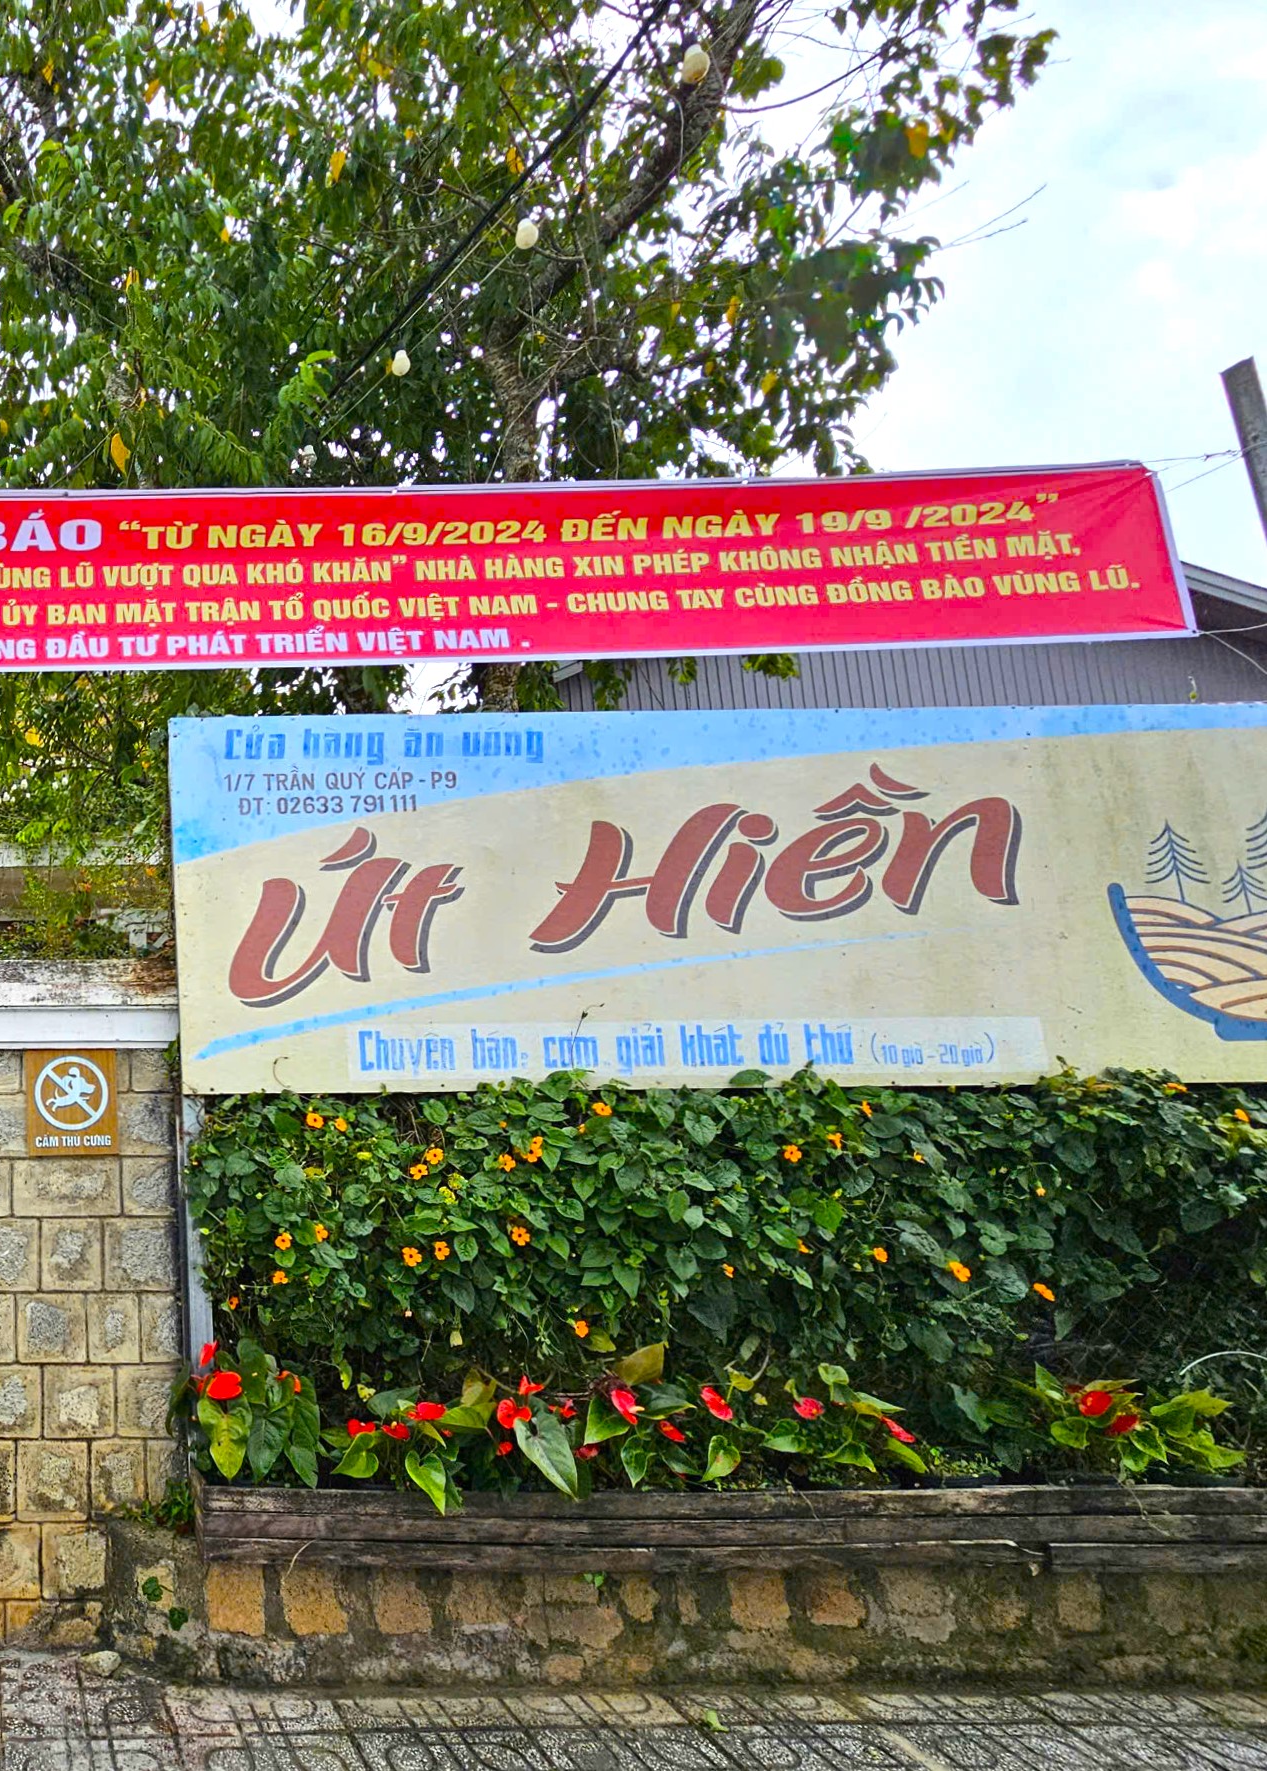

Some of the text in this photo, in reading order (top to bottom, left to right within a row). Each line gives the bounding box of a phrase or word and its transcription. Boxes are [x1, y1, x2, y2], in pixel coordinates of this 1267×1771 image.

[208, 519, 323, 549] NGÀY
[338, 520, 547, 546] 16/9/2024
[560, 510, 648, 542] ĐẾN
[662, 509, 780, 539] NGÀY
[60, 561, 94, 588] LŨ
[102, 562, 174, 591] VƯỢT
[182, 563, 239, 588] QUA
[246, 558, 304, 585] KHÓ
[415, 555, 477, 581] NHÀ
[484, 553, 565, 580] HÀNG
[572, 555, 625, 577] XIN
[632, 548, 710, 575] PHÉP
[719, 545, 823, 572] KHÔNG
[830, 540, 919, 569] NHẬN
[924, 533, 997, 562] TIỀN
[2, 598, 38, 626] ỦY
[47, 603, 107, 625] BAN
[115, 598, 177, 628] MẶT
[184, 597, 261, 626] TRẬN
[268, 591, 304, 621] TỔ
[312, 591, 390, 622] QUỐC
[397, 592, 460, 621] VIỆT
[468, 594, 538, 616] NAM
[566, 590, 670, 613] CHUNG
[675, 588, 724, 610] TAY
[734, 582, 819, 608] CÙNG
[826, 576, 914, 604] ĐỒNG
[920, 573, 986, 600] BÀO
[992, 570, 1081, 596] VÙNG
[1088, 564, 1140, 591] LŨ.
[44, 630, 109, 659] ĐẦU
[117, 633, 160, 657] TƯ
[166, 630, 247, 656] PHÁT
[255, 624, 349, 654] TRIỂN
[356, 627, 424, 655] VIỆT
[433, 628, 510, 650] NAM
[224, 724, 286, 760] Cửa
[303, 727, 385, 766] hàng
[403, 727, 444, 758] ăn
[223, 773, 255, 793] 1/7
[263, 765, 315, 792] TRẦN
[325, 767, 365, 791] QUÝ
[238, 796, 271, 816] ĐT:
[276, 796, 344, 815] 02633
[228, 762, 1023, 1008] Út Hiền
[680, 1023, 744, 1067] khát
[758, 1021, 791, 1066] đủ
[938, 1043, 958, 1064] 20
